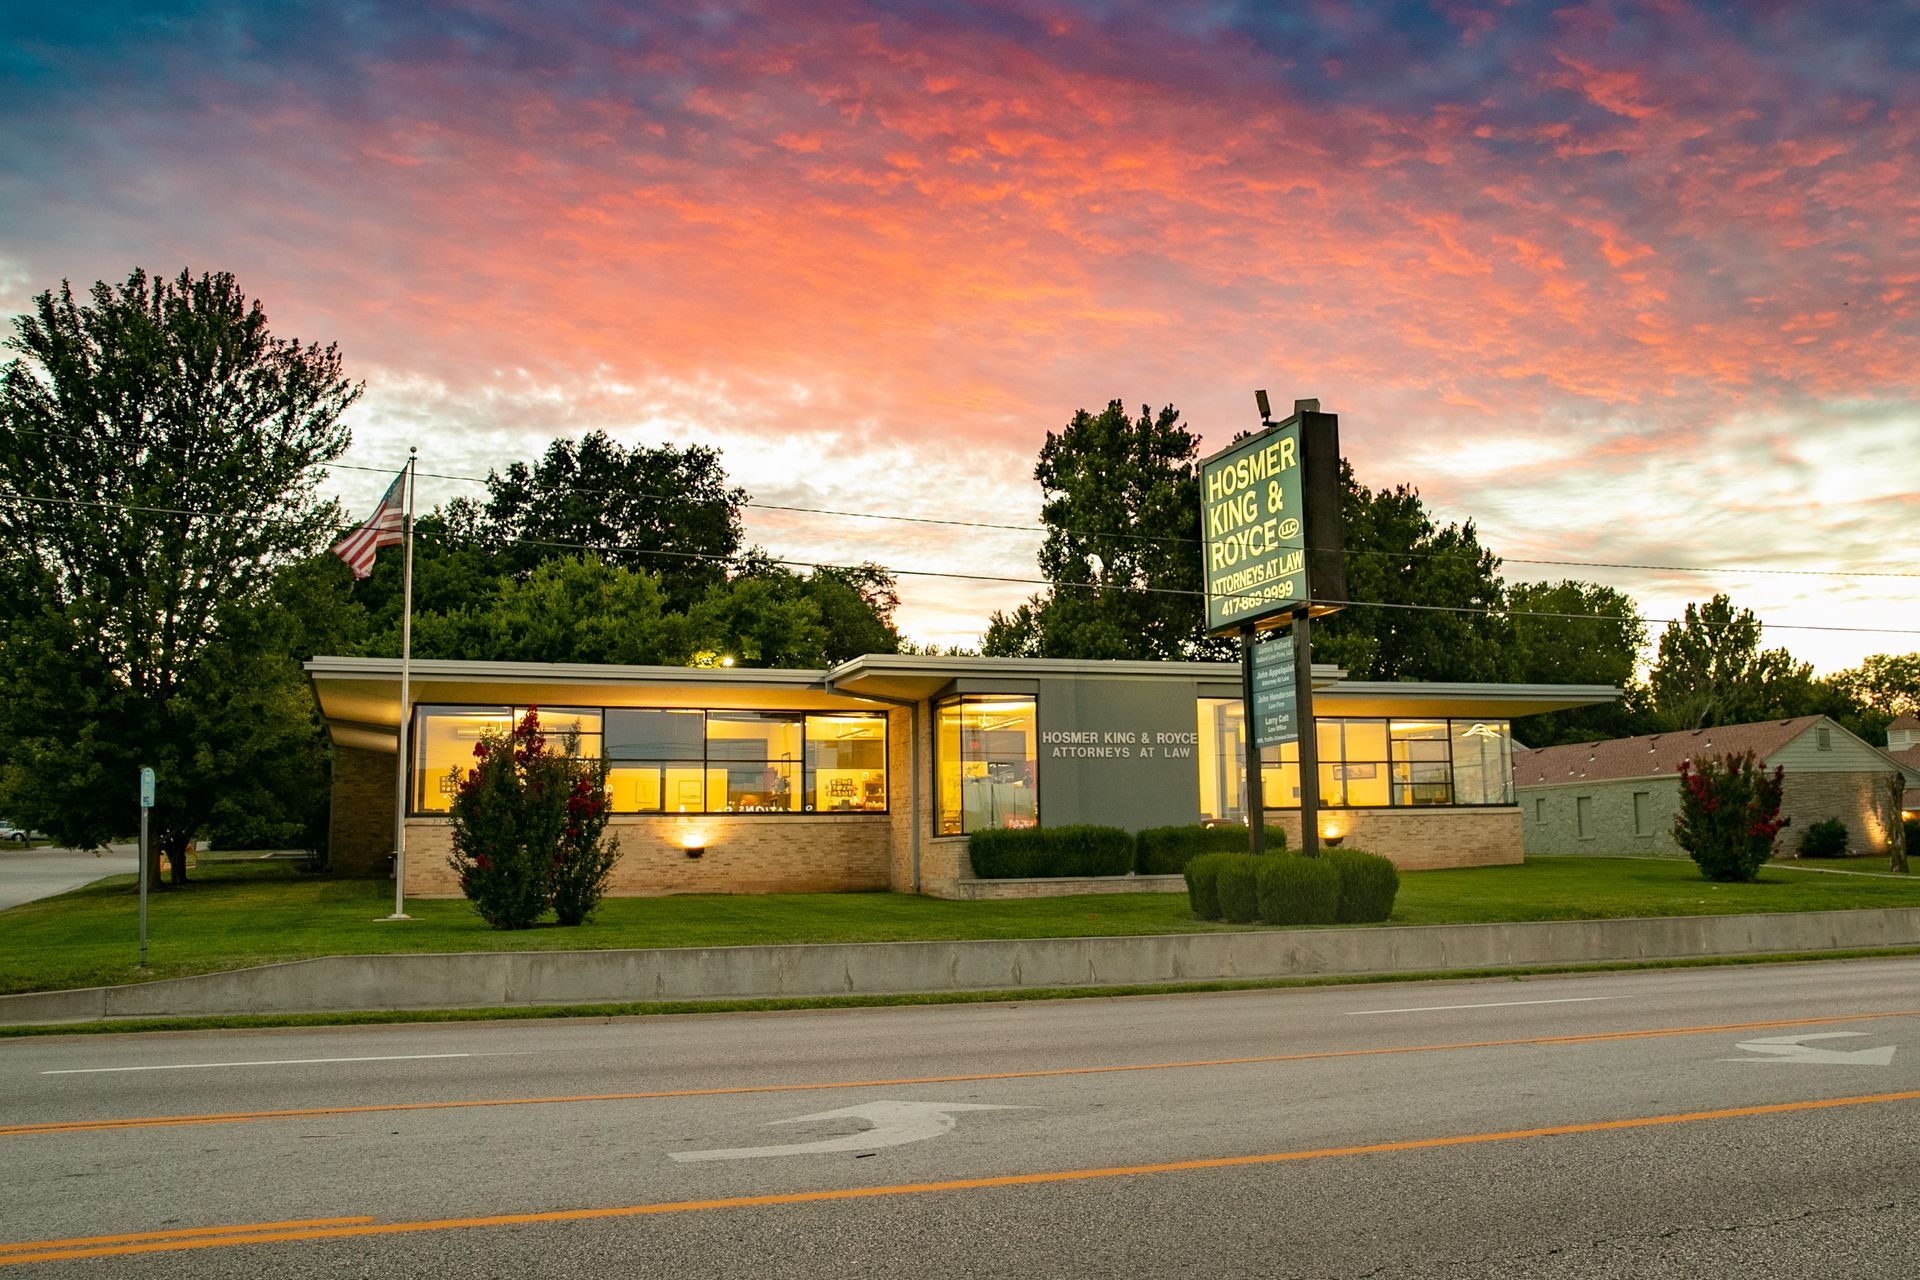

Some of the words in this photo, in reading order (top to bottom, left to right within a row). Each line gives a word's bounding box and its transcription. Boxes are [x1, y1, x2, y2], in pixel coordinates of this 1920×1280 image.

[1208, 436, 1297, 504] HOSMER
[1210, 490, 1258, 538] KING
[1267, 480, 1284, 514] &
[1210, 517, 1278, 572] ROYCE
[1211, 566, 1264, 598] ATTORNEYS
[1265, 558, 1278, 580] AT
[1279, 549, 1304, 571] LAW
[1258, 670, 1269, 679] John
[1258, 694, 1270, 703] John
[1270, 690, 1296, 700] Henderson
[1265, 716, 1278, 725] Larry
[1042, 731, 1099, 744] HOSMER
[1104, 731, 1136, 744] KING
[1141, 731, 1150, 744] &
[1156, 732, 1198, 744] ROYCE
[1052, 747, 1130, 758] ATTORNEYS
[1139, 747, 1155, 758] AT
[1164, 747, 1190, 758] LAW
